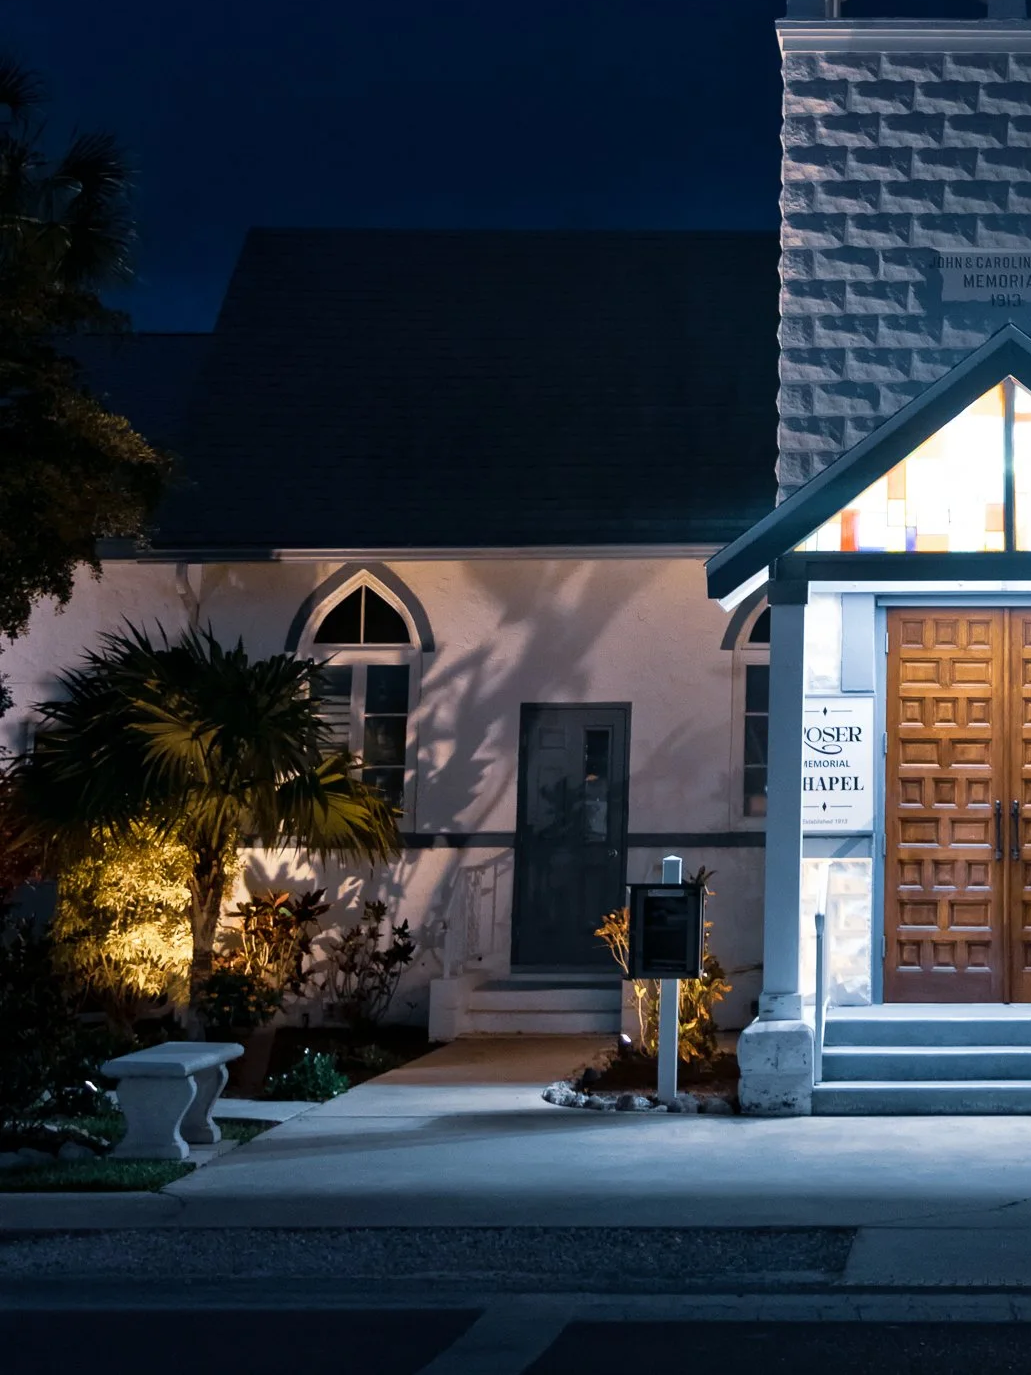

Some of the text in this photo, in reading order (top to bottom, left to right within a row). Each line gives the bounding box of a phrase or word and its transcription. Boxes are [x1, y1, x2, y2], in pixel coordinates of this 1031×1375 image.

[929, 256, 962, 269] JOHN
[965, 256, 973, 269] &
[990, 293, 1023, 307] 1913
[804, 726, 862, 755] OSER
[803, 776, 865, 791] HAPEL
